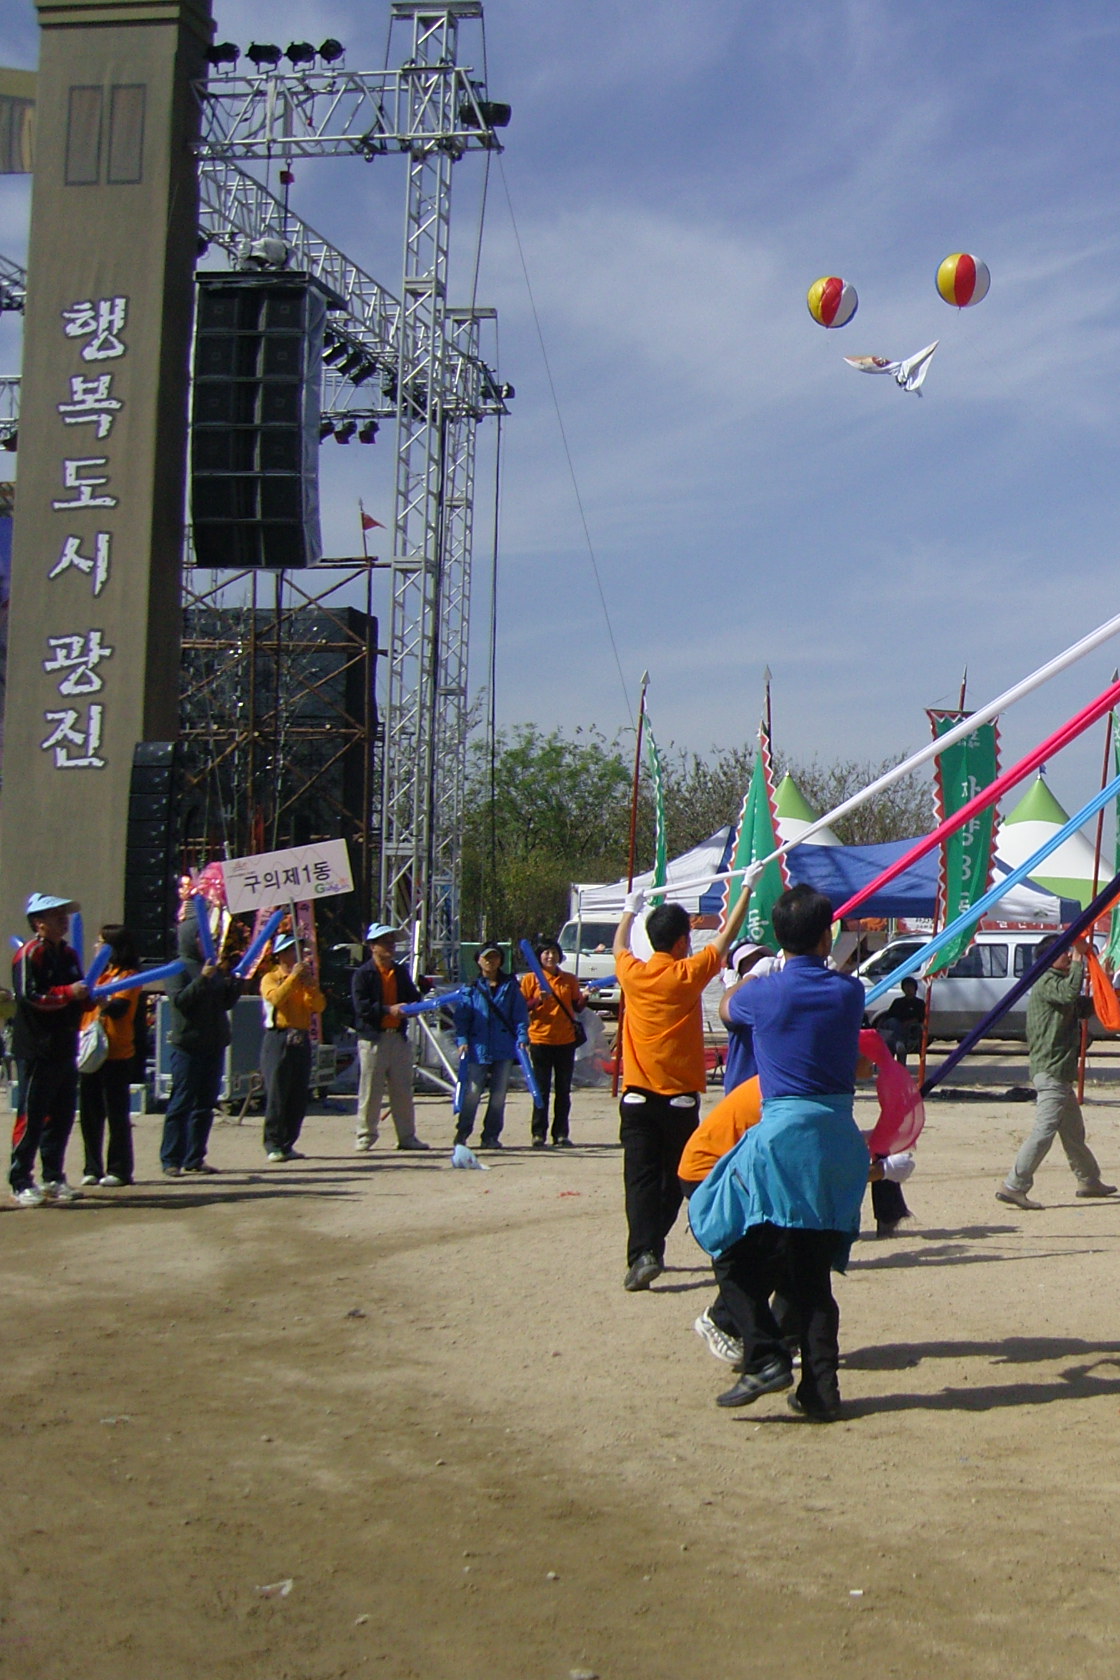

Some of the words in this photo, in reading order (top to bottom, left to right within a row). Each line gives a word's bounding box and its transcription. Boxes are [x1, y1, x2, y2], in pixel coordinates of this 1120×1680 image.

[50, 297, 129, 595] 행복도시
[41, 630, 112, 769] 광진
[243, 861, 331, 894] 구의제1동
